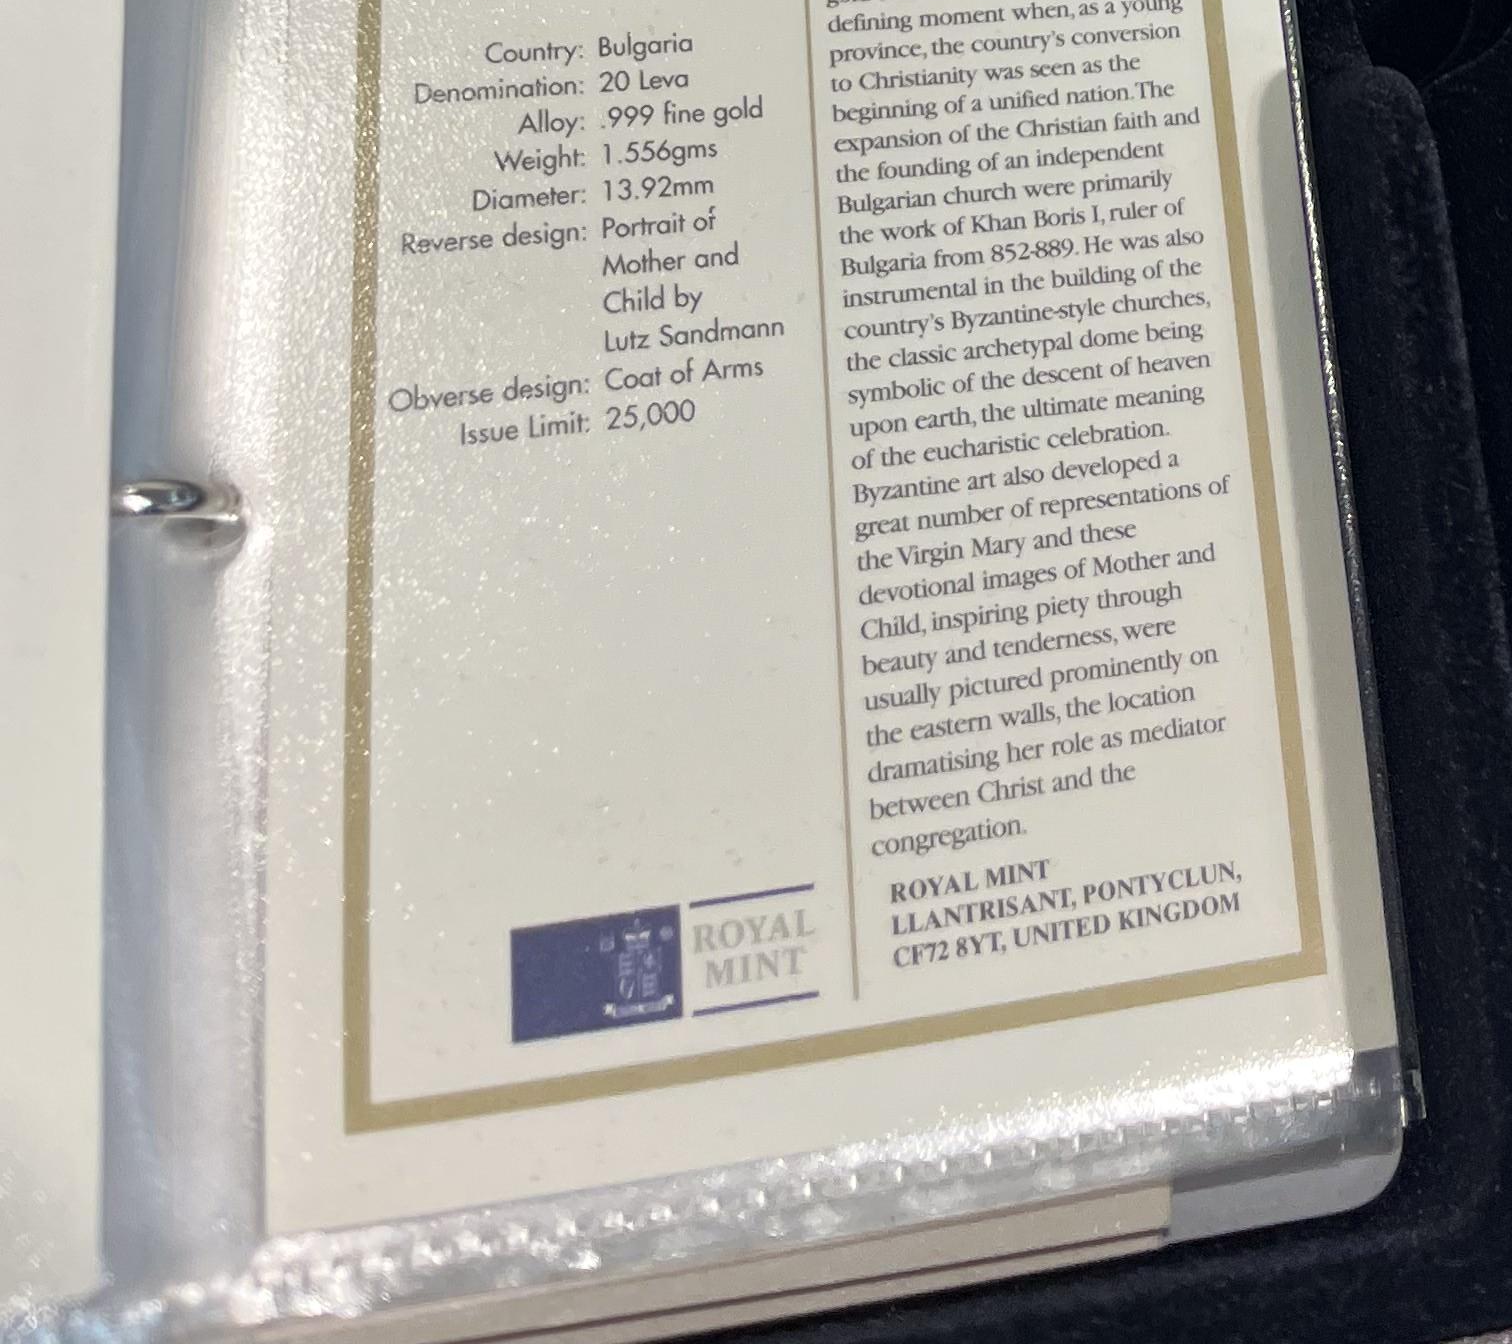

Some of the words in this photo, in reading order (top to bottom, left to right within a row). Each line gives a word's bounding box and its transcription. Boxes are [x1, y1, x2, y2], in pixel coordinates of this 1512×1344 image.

[485, 42, 583, 66] Country:
[598, 32, 692, 62] Bulgaria
[830, 43, 927, 68] province,
[932, 38, 964, 55] the
[1072, 24, 1180, 45] conversion
[414, 76, 584, 104] Denomination:
[600, 70, 630, 92] 20
[640, 70, 688, 90] Leva
[518, 109, 584, 138] Alloy:
[601, 105, 654, 128] .999
[664, 100, 704, 124] fine
[714, 94, 763, 128] gold
[494, 144, 585, 176] Weight:
[604, 140, 718, 166] 1.556gms
[836, 164, 870, 183] the
[878, 158, 971, 180] founding
[978, 152, 1000, 171] of
[1005, 155, 1029, 170] an
[1037, 142, 1164, 168] independent
[473, 187, 586, 212] Diameter:
[604, 176, 714, 201] 13.92mm
[838, 191, 936, 216] Bulgarian
[944, 182, 1016, 204] church
[1023, 182, 1074, 198] were
[1082, 169, 1172, 199] primarily
[402, 233, 493, 255] Reverse
[502, 222, 586, 250] design:
[602, 212, 686, 238] Portrait
[693, 206, 716, 232] of
[840, 252, 927, 278] Bulgaria
[934, 249, 984, 268] from
[992, 239, 1078, 263] 852-889.
[1084, 236, 1112, 254] He
[1120, 235, 1159, 250] was
[1166, 228, 1204, 247] also
[602, 248, 686, 276] Mother
[695, 240, 739, 268] and
[603, 284, 664, 314] Child
[674, 284, 702, 314] by
[605, 330, 650, 352] Lutz
[660, 317, 784, 347] Sandmann
[847, 352, 881, 372] the
[889, 344, 956, 367] classic
[964, 332, 1072, 360] archetypal
[1080, 329, 1139, 348] dome
[1146, 322, 1203, 342] being
[388, 384, 494, 412] Obverse
[502, 374, 589, 404] design:
[605, 367, 662, 390] Coat
[670, 357, 694, 384] of
[702, 359, 764, 382] Arms
[848, 378, 945, 409] symbolic
[952, 372, 975, 393] of
[982, 371, 1014, 390] the
[1022, 364, 1103, 386] descent
[1110, 356, 1132, 376] of
[1137, 355, 1210, 374] heaven
[461, 423, 518, 446] Issue
[529, 412, 590, 438] Limit:
[606, 399, 695, 431] 25,000
[852, 448, 875, 470] of
[880, 446, 916, 466] the
[924, 433, 1040, 462] eucharistic
[1047, 421, 1170, 448] celebration.
[856, 516, 910, 542] great
[918, 504, 1004, 530] number
[1011, 497, 1034, 518] of
[1040, 483, 1202, 518] representations
[1208, 474, 1230, 495] of
[859, 572, 974, 605] devotional
[983, 567, 1057, 590] images
[1064, 558, 1086, 579] of
[1093, 551, 1170, 576] Mother
[1177, 542, 1216, 565] and
[861, 613, 926, 640] Child,
[932, 604, 1028, 633] inspiring
[1037, 596, 1089, 624] piety
[1097, 581, 1182, 610] through
[864, 683, 940, 711] usually
[950, 667, 1043, 706] pictured
[1050, 650, 1182, 692] prominently
[1190, 649, 1220, 666] on
[870, 791, 970, 820] between
[977, 777, 1045, 802] Christ
[1052, 766, 1092, 792] and
[1101, 762, 1136, 784] the
[891, 872, 978, 904] ROYAL
[986, 859, 1050, 888] MINT
[892, 888, 1076, 935] LLANTRISANT,
[1083, 861, 1242, 904] PONTYCLUN,
[693, 908, 816, 955] ROYAL
[894, 940, 949, 968] CF72
[956, 932, 1006, 957] 8YT,
[1014, 915, 1110, 947] UNITED
[1118, 892, 1239, 930] KINGDOM
[705, 946, 808, 989] MINT
